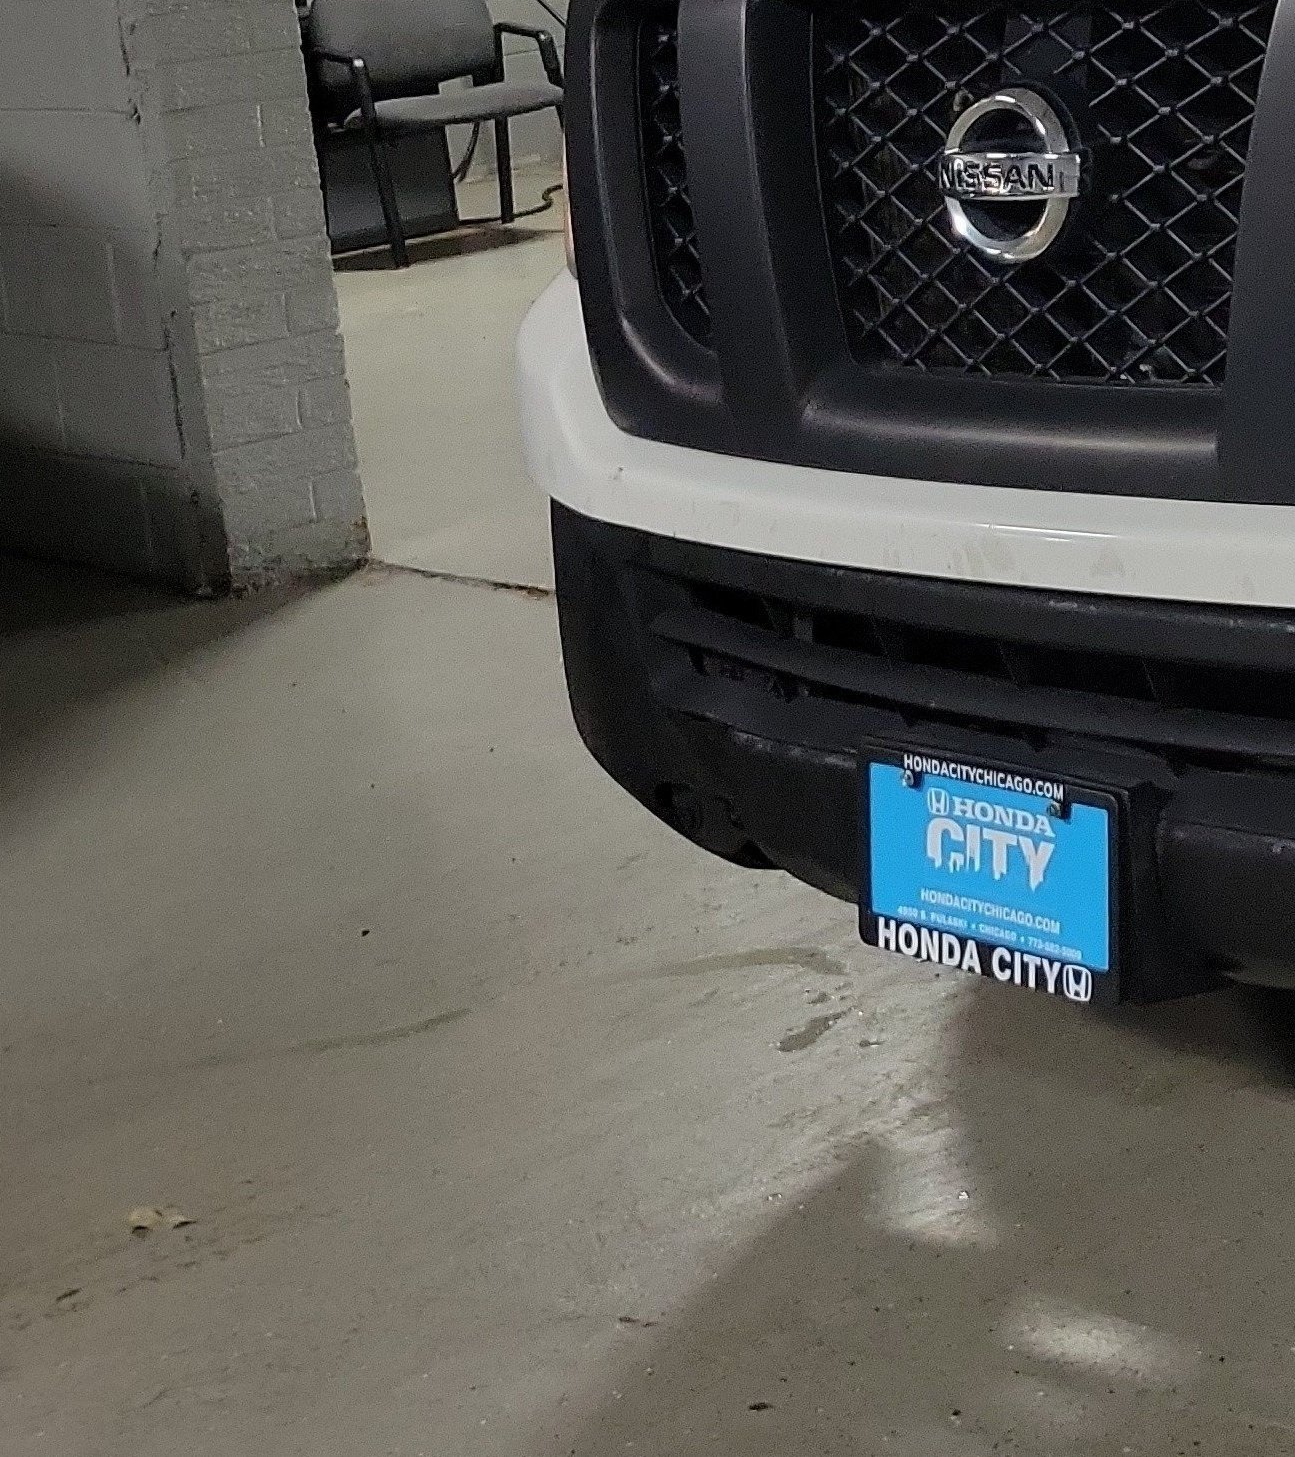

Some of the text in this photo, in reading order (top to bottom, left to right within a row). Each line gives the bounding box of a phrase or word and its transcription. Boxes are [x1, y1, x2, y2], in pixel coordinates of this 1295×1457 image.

[938, 158, 1055, 191] NISSAN
[903, 753, 1064, 800] HONDACITYCHICAGO.COM
[952, 795, 1056, 838] HONDA
[926, 817, 1056, 892] CITY
[920, 888, 1061, 935] HONDACITYCHICAGO.COM
[877, 916, 982, 975] HONDA
[991, 946, 1062, 993] CITY
